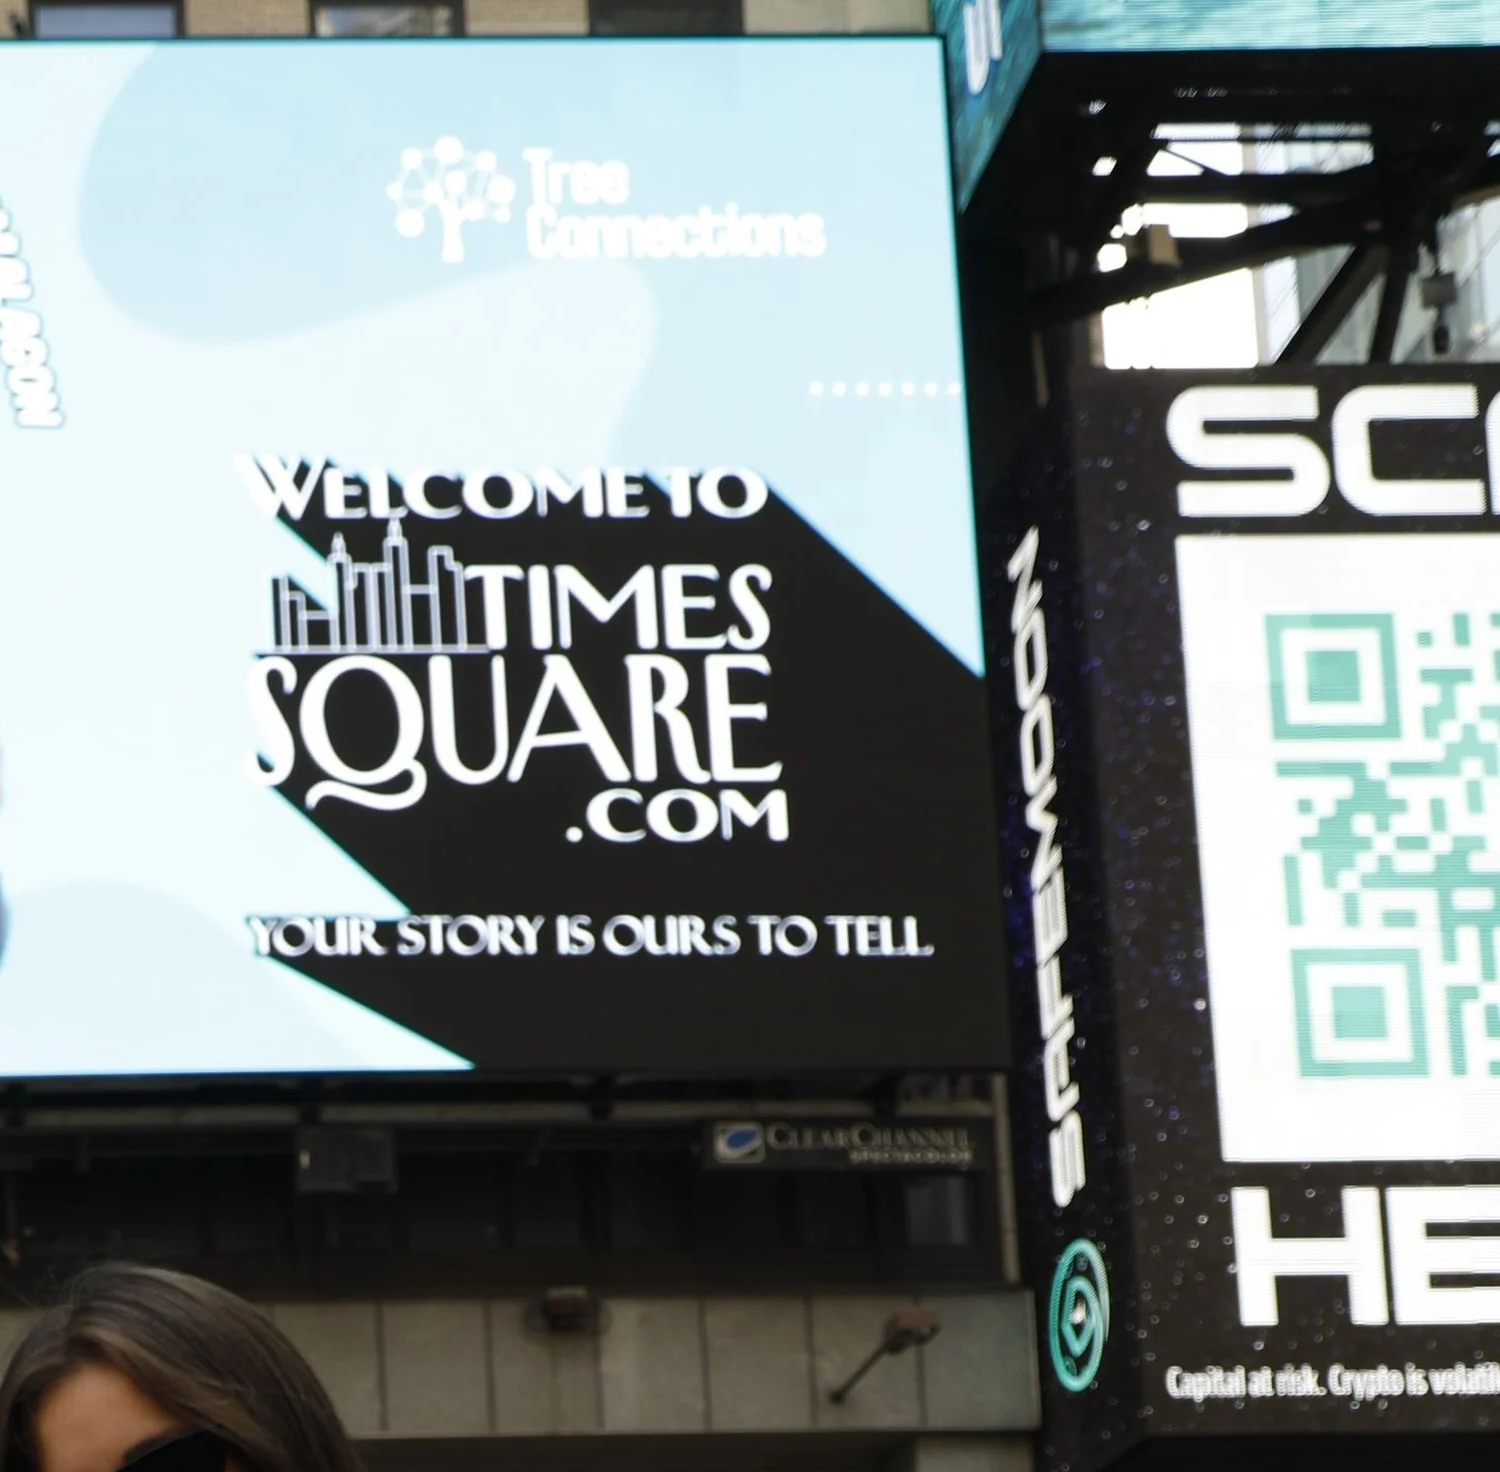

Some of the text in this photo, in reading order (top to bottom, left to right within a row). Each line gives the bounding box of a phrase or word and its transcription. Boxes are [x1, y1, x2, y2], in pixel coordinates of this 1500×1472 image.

[522, 147, 630, 205] Tree
[526, 202, 827, 259] Connections
[1166, 384, 1500, 518] SC
[234, 452, 769, 522] WELCOME TO
[464, 563, 773, 651] TIMES
[245, 654, 784, 811] SQUARE
[564, 788, 790, 843] .COM
[246, 913, 935, 958] YOUR STORY IS OURS TO TELL
[1231, 1184, 1500, 1327] HE
[1165, 1365, 1247, 1403] Capital
[1248, 1366, 1275, 1397] at
[1404, 1362, 1429, 1396] is
